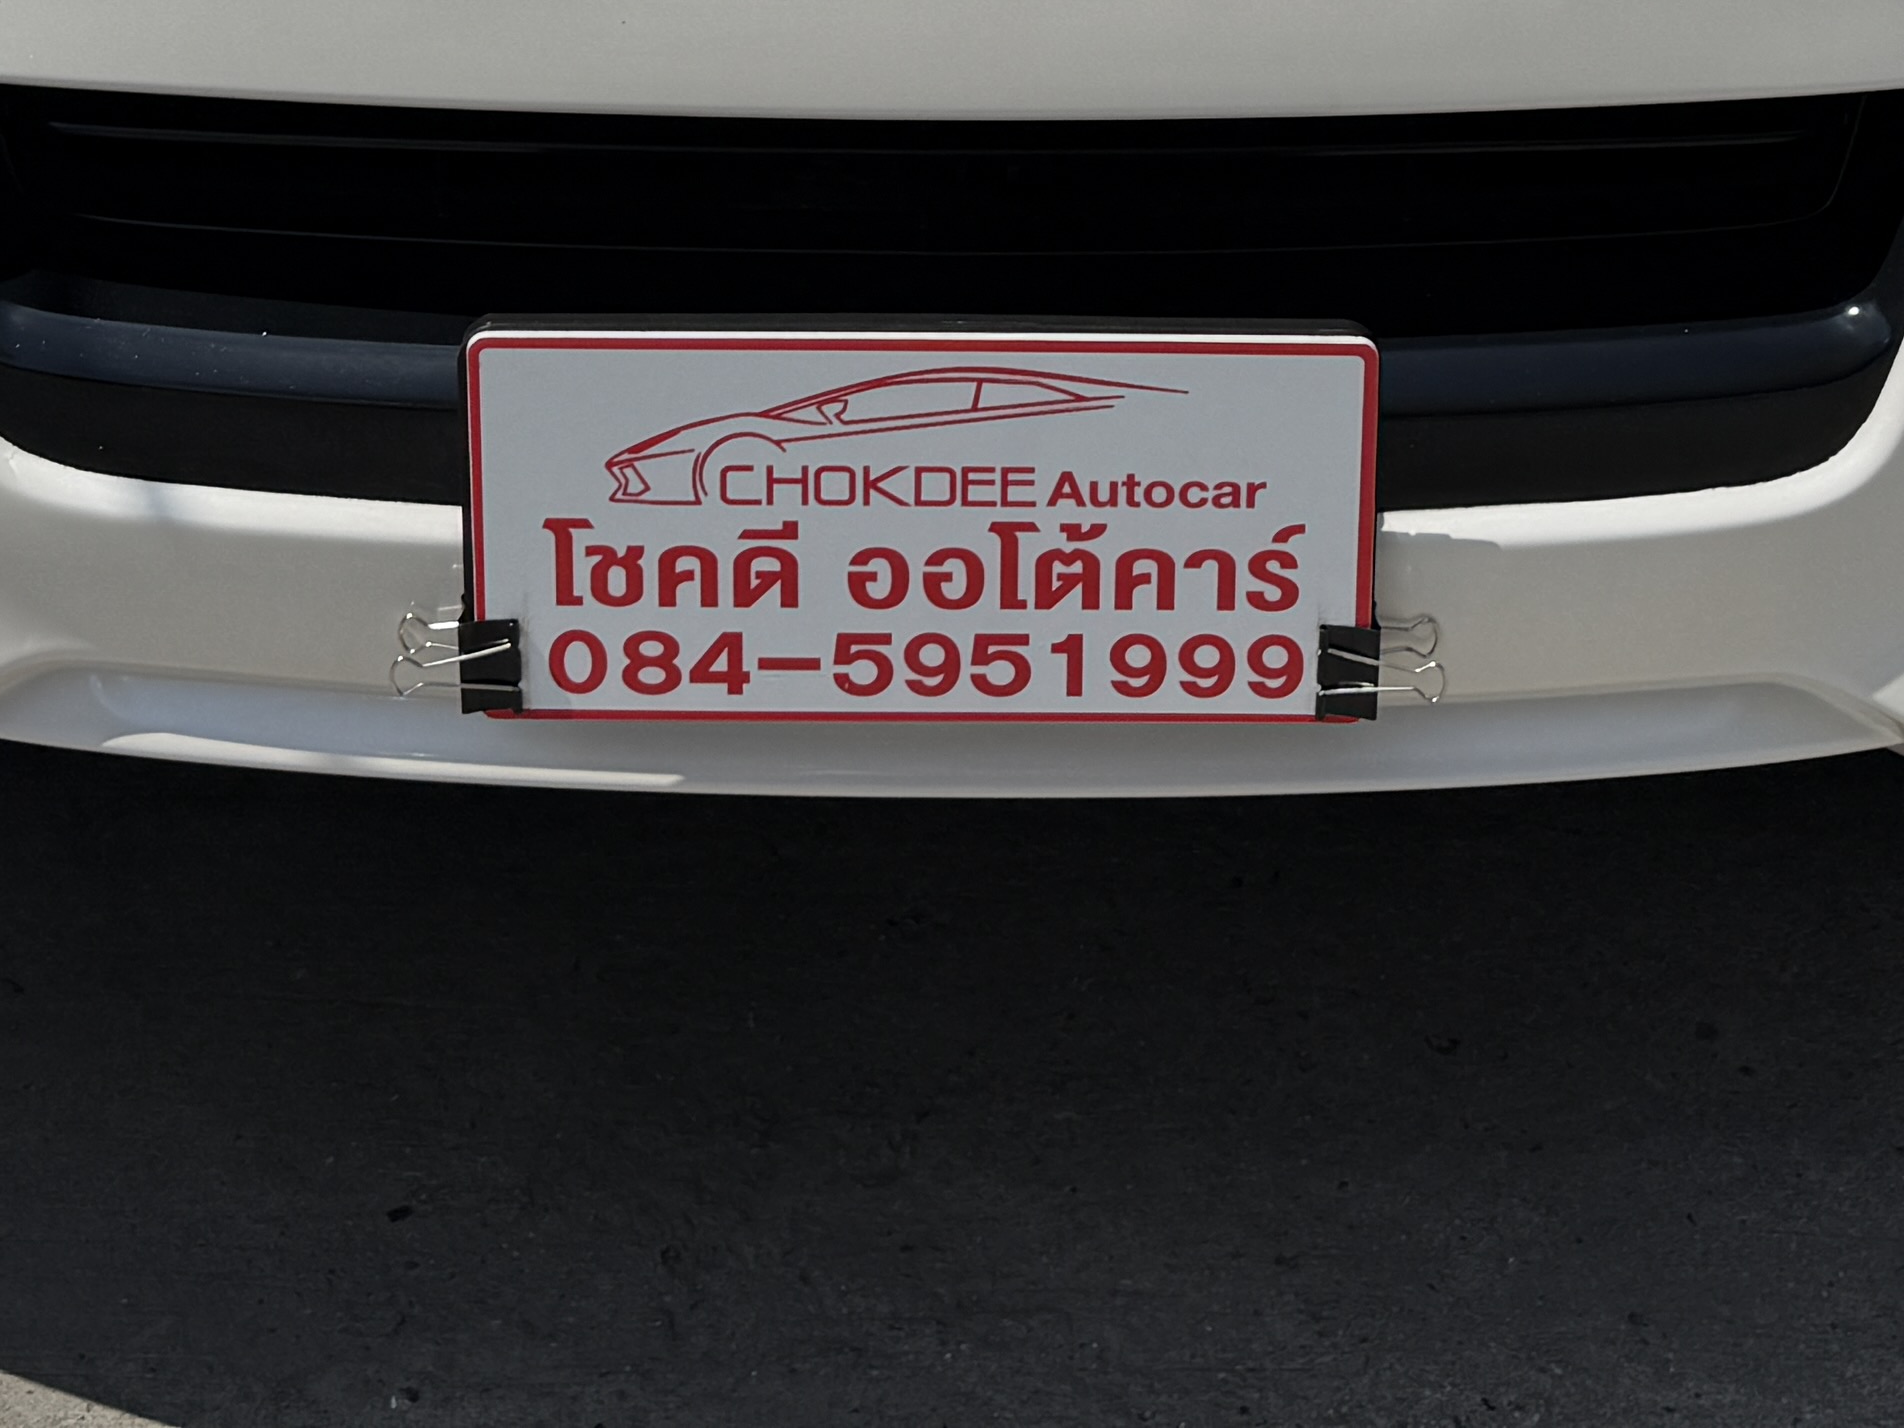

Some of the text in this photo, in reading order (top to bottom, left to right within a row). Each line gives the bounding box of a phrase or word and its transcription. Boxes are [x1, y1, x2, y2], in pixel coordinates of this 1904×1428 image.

[719, 464, 1267, 509] CHOKDEE Autocar
[542, 518, 1306, 612] โชคดี ออโต้คาร์
[548, 630, 1305, 699] 084-5951999
